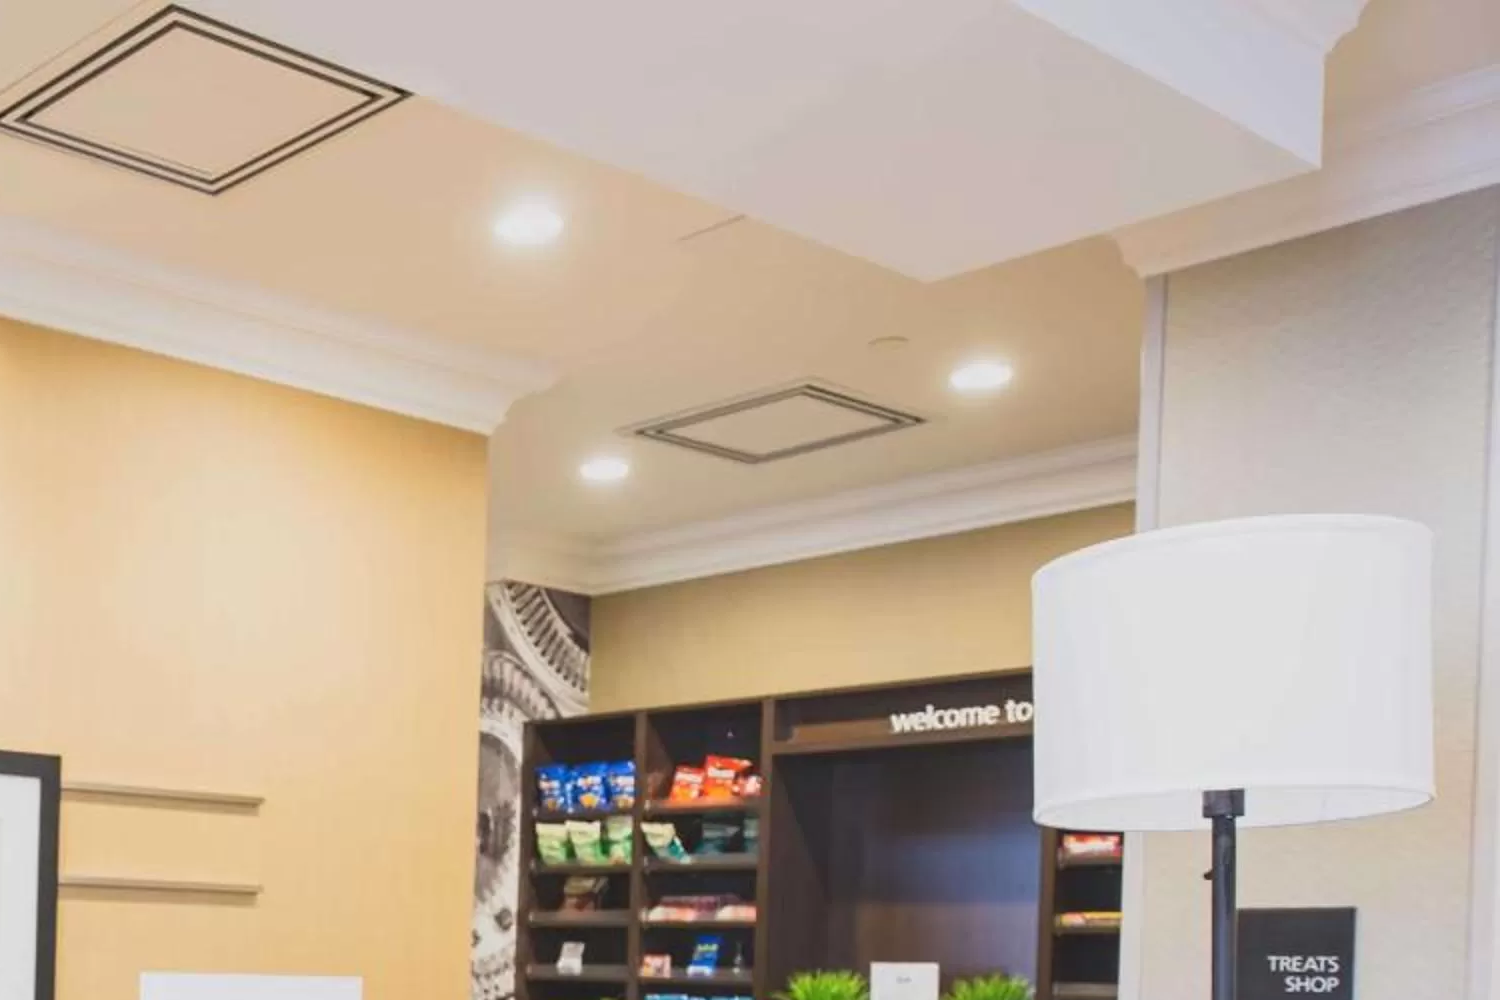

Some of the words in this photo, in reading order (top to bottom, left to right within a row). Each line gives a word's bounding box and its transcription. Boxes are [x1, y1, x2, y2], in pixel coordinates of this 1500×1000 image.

[891, 705, 1000, 733] welcome
[1006, 699, 1034, 723] to
[1267, 955, 1340, 973] TREATS
[1284, 976, 1340, 993] SHOP
